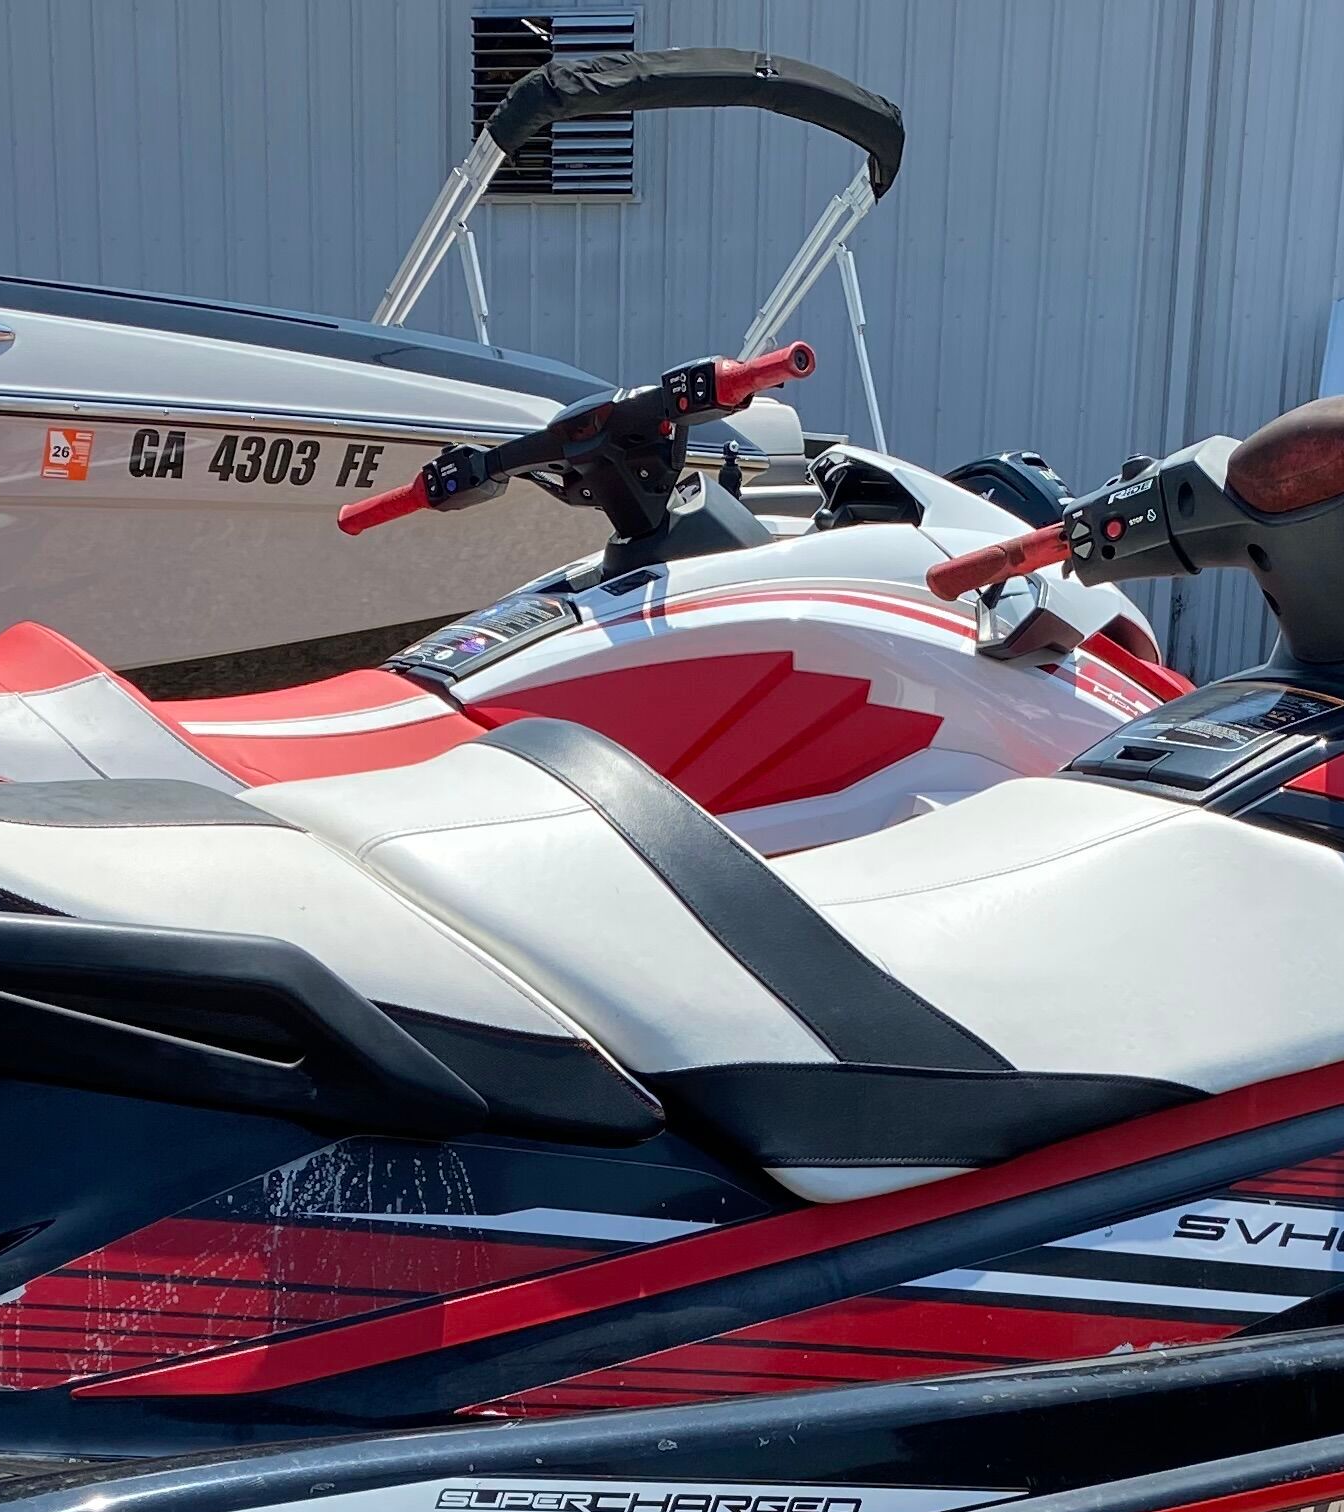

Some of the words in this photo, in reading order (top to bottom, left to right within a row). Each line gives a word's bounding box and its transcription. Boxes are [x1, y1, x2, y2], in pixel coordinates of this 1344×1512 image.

[52, 445, 70, 458] 26
[128, 428, 187, 479] GA
[207, 434, 321, 486] 4303
[335, 443, 385, 488] FE
